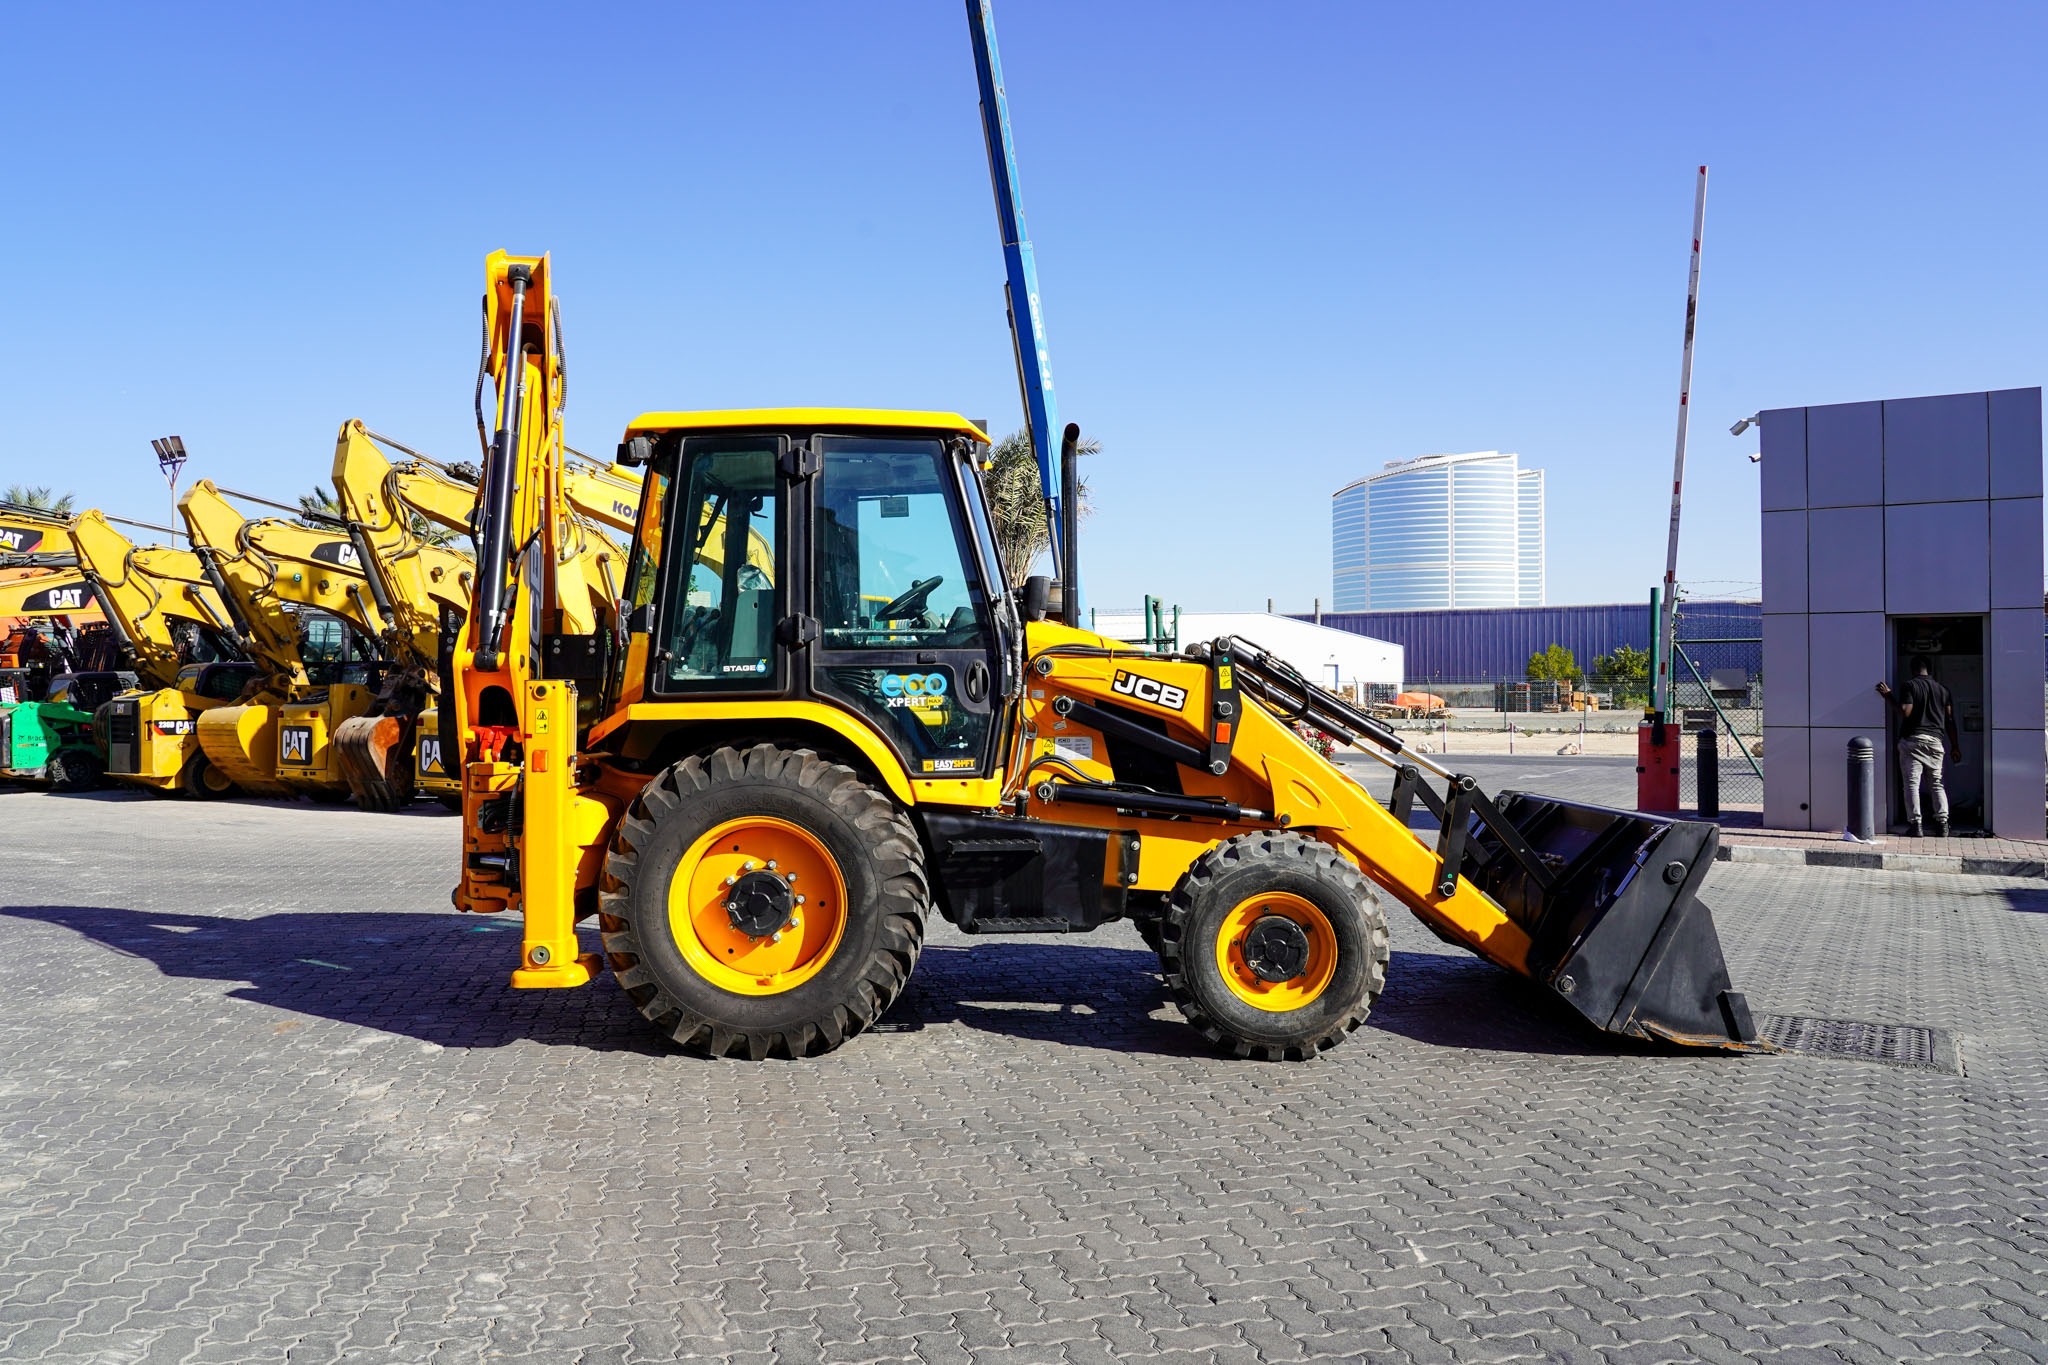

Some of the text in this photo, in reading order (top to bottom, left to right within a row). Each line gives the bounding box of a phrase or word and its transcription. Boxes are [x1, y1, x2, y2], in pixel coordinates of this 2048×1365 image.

[338, 543, 363, 566] CA
[48, 589, 82, 609] CAT
[881, 673, 947, 697] eco
[1113, 674, 1186, 709] JCB
[887, 697, 926, 708] XPERT
[176, 720, 196, 734] CAT
[282, 730, 309, 761] CAT
[421, 739, 444, 772] CA
